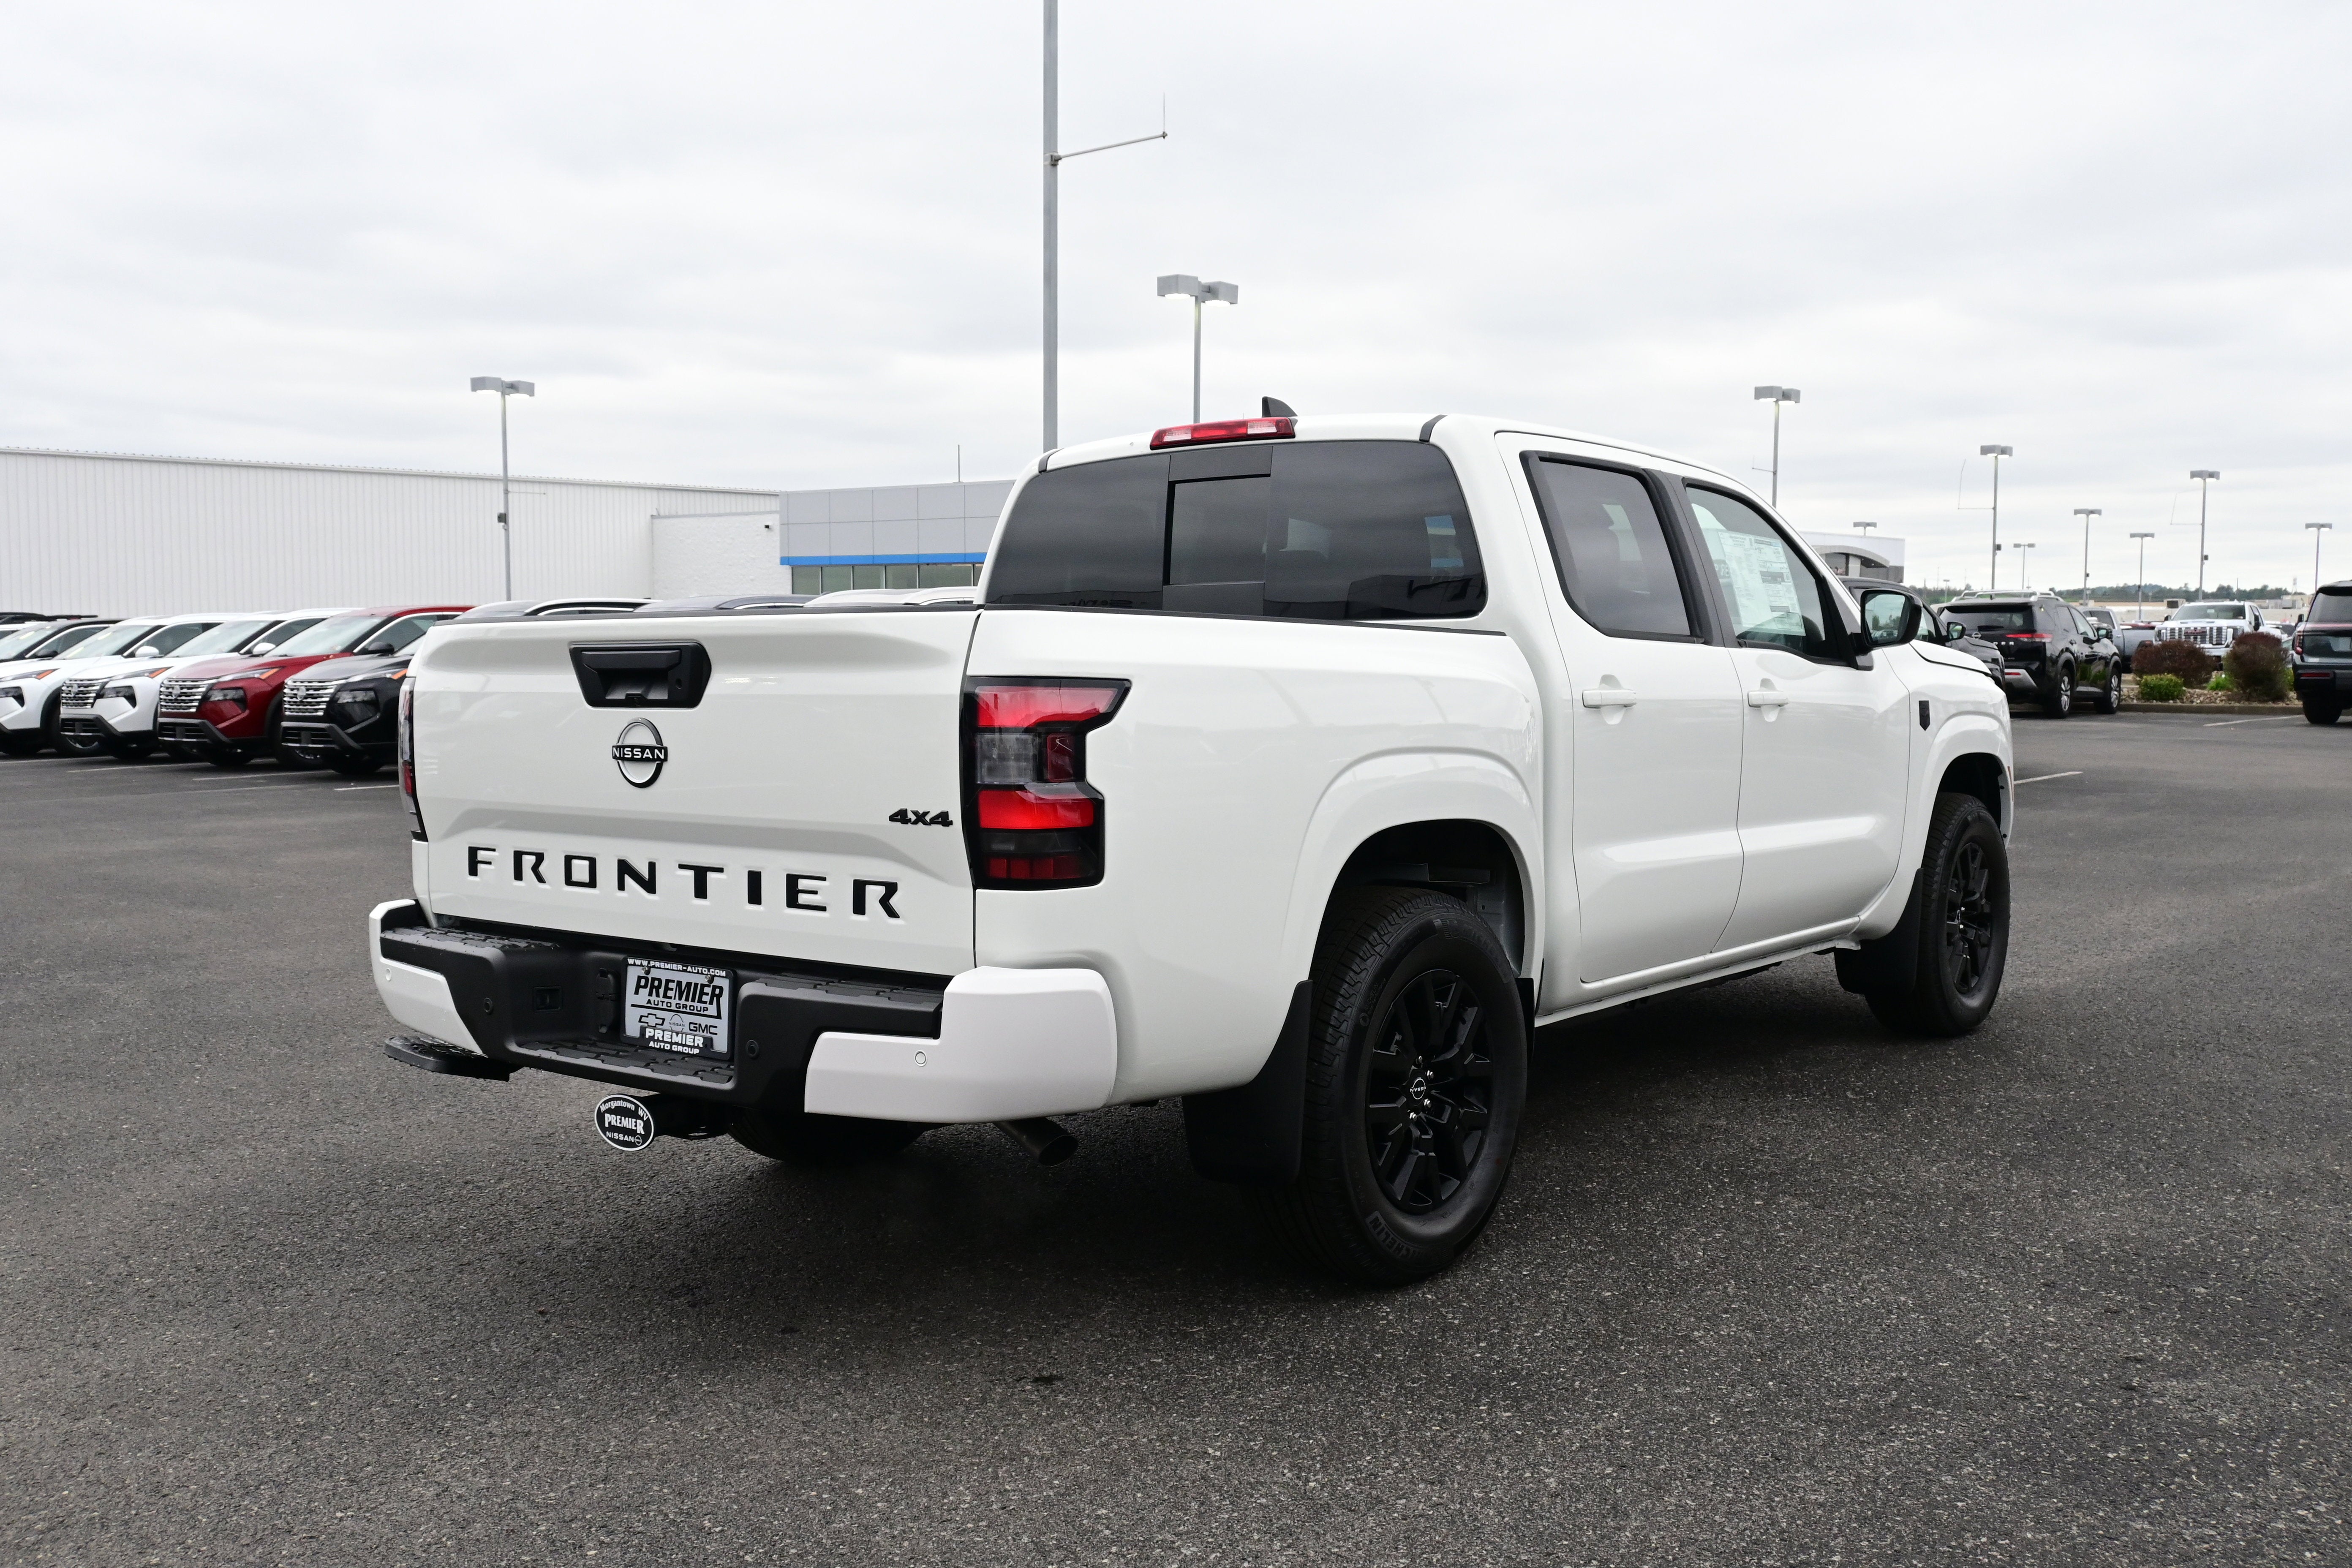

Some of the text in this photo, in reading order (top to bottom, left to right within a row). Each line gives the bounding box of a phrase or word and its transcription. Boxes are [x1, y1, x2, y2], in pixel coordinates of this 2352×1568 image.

[612, 747, 664, 759] NISSAN
[468, 846, 900, 919] FRONTIER
[627, 958, 726, 977] WWW.PREMIER-AUTO.COM
[634, 975, 724, 1006] PREMIER
[646, 999, 708, 1013] AUTO GROUP
[645, 1028, 704, 1048] PREMIER
[689, 1022, 718, 1035] GMC
[649, 1041, 700, 1055] AUTO GROUP
[600, 1099, 648, 1121] Morgantown WV
[604, 1113, 645, 1135] PREMIER
[606, 1131, 634, 1143] NISSAN
